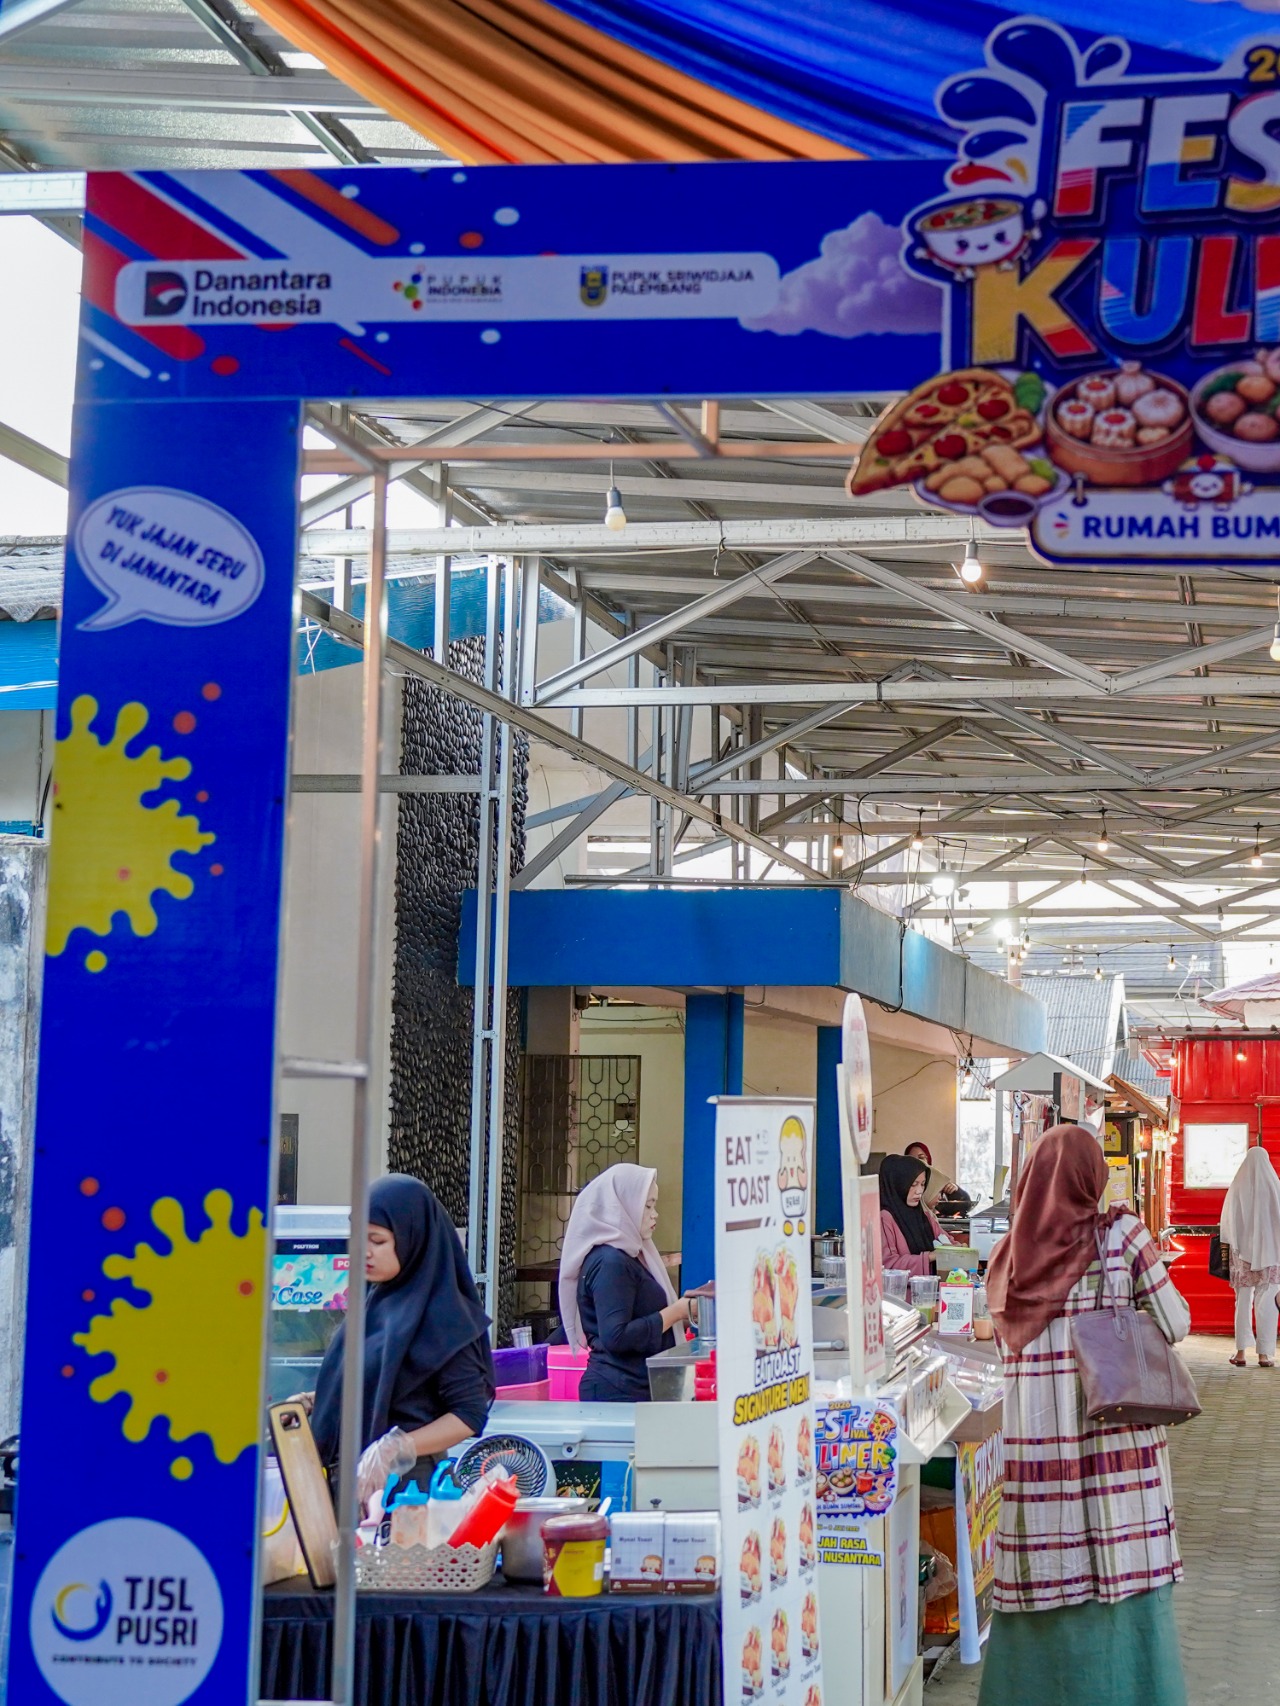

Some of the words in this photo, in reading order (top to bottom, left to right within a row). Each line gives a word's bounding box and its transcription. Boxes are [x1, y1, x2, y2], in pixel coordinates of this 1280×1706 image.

[194, 268, 332, 292] Danantara
[612, 271, 664, 283] PUPUK
[612, 283, 703, 295] PALEMBANG
[193, 293, 322, 317] Indonesia
[1083, 515, 1200, 539] RUMAH
[106, 505, 145, 537] YUK
[141, 523, 199, 560] JAJAN
[197, 548, 247, 581] SERU
[100, 540, 124, 564] DI
[121, 552, 222, 609] JANANTARA
[725, 1136, 752, 1166] EAT
[727, 1175, 770, 1207] TOAST
[277, 1286, 323, 1306] Case
[733, 1379, 789, 1427] SIGNATURE
[829, 1401, 852, 1410] 2026
[815, 1409, 855, 1441] EST
[850, 1429, 870, 1440] IVAL
[816, 1442, 890, 1470] LINER
[840, 1538, 867, 1550] RASA
[823, 1551, 882, 1567] NUSANTARA
[123, 1576, 193, 1612] TJSL
[116, 1616, 198, 1647] PUSRI
[129, 1655, 144, 1665] TO
